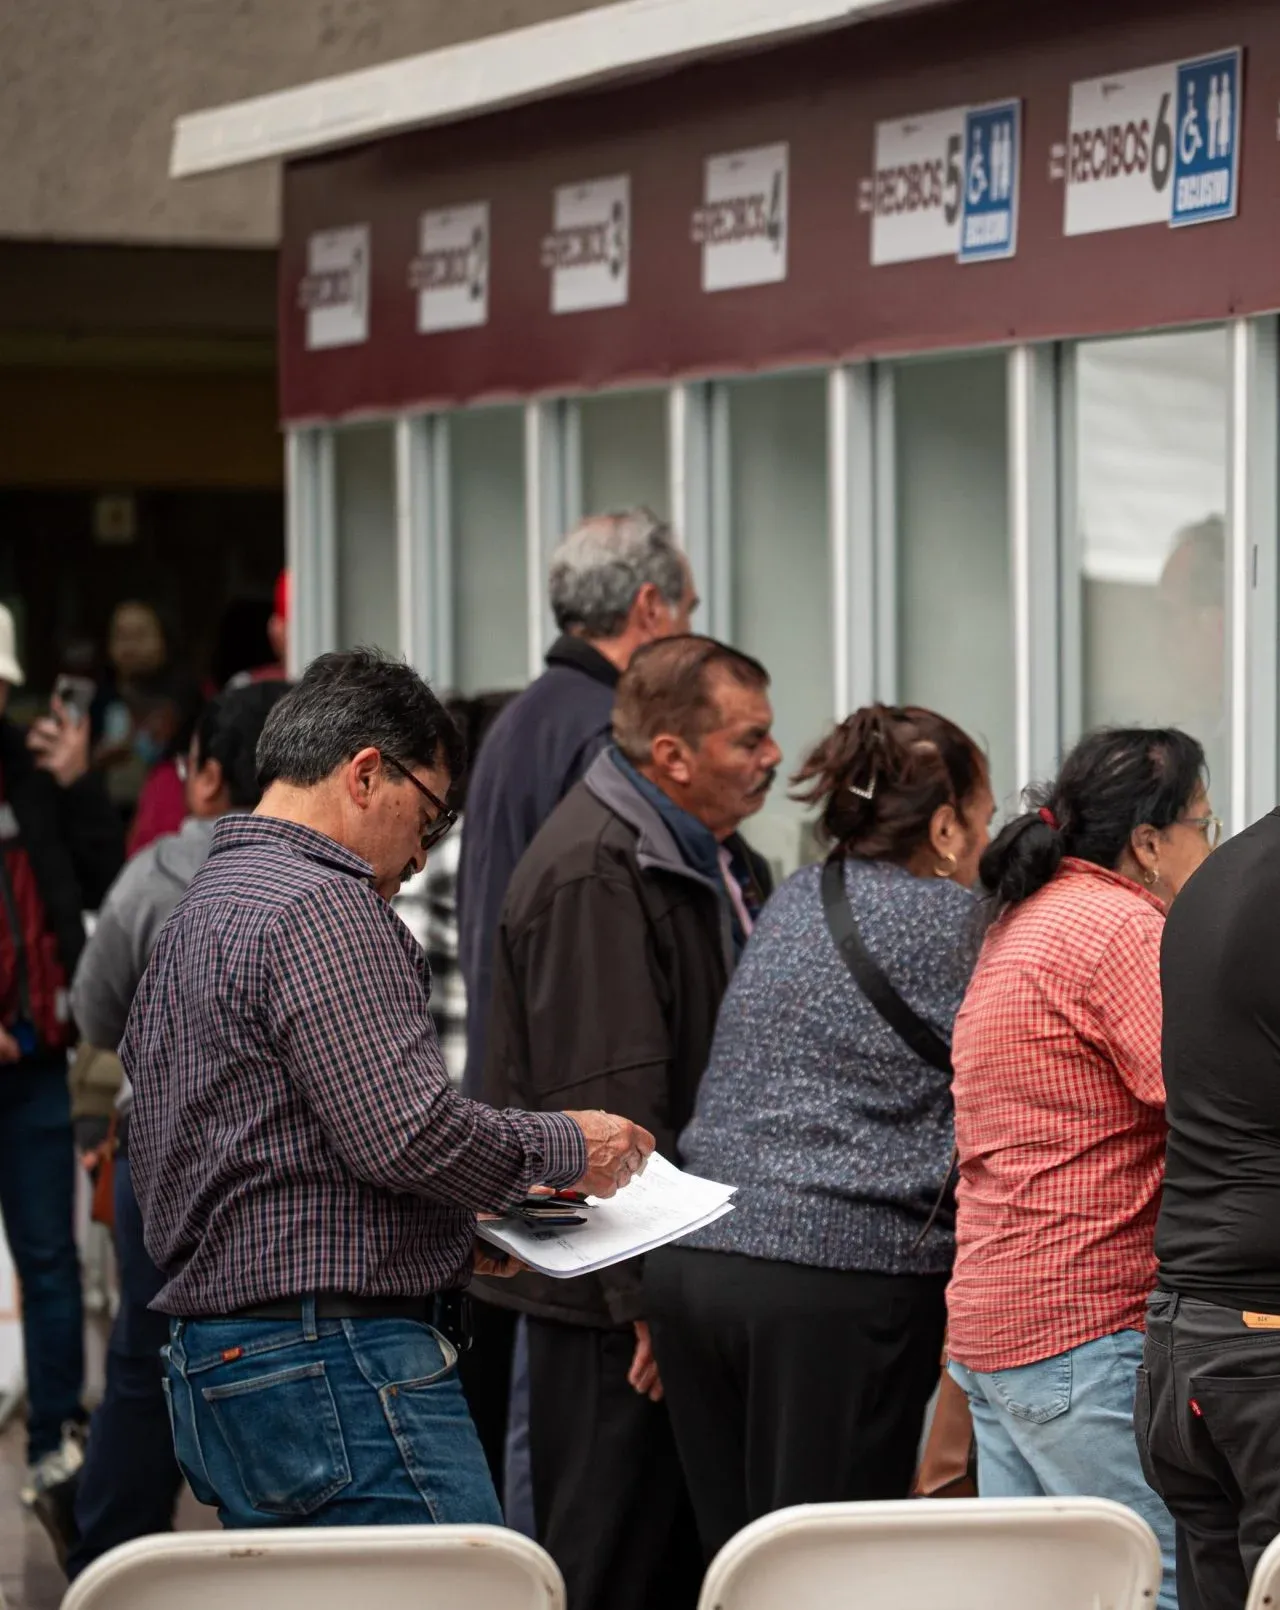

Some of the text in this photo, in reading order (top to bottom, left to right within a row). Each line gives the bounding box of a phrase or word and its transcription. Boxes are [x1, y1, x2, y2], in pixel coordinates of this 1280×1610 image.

[944, 132, 962, 227] 5
[1070, 118, 1150, 184] RECIBOS
[1151, 91, 1173, 193] 6
